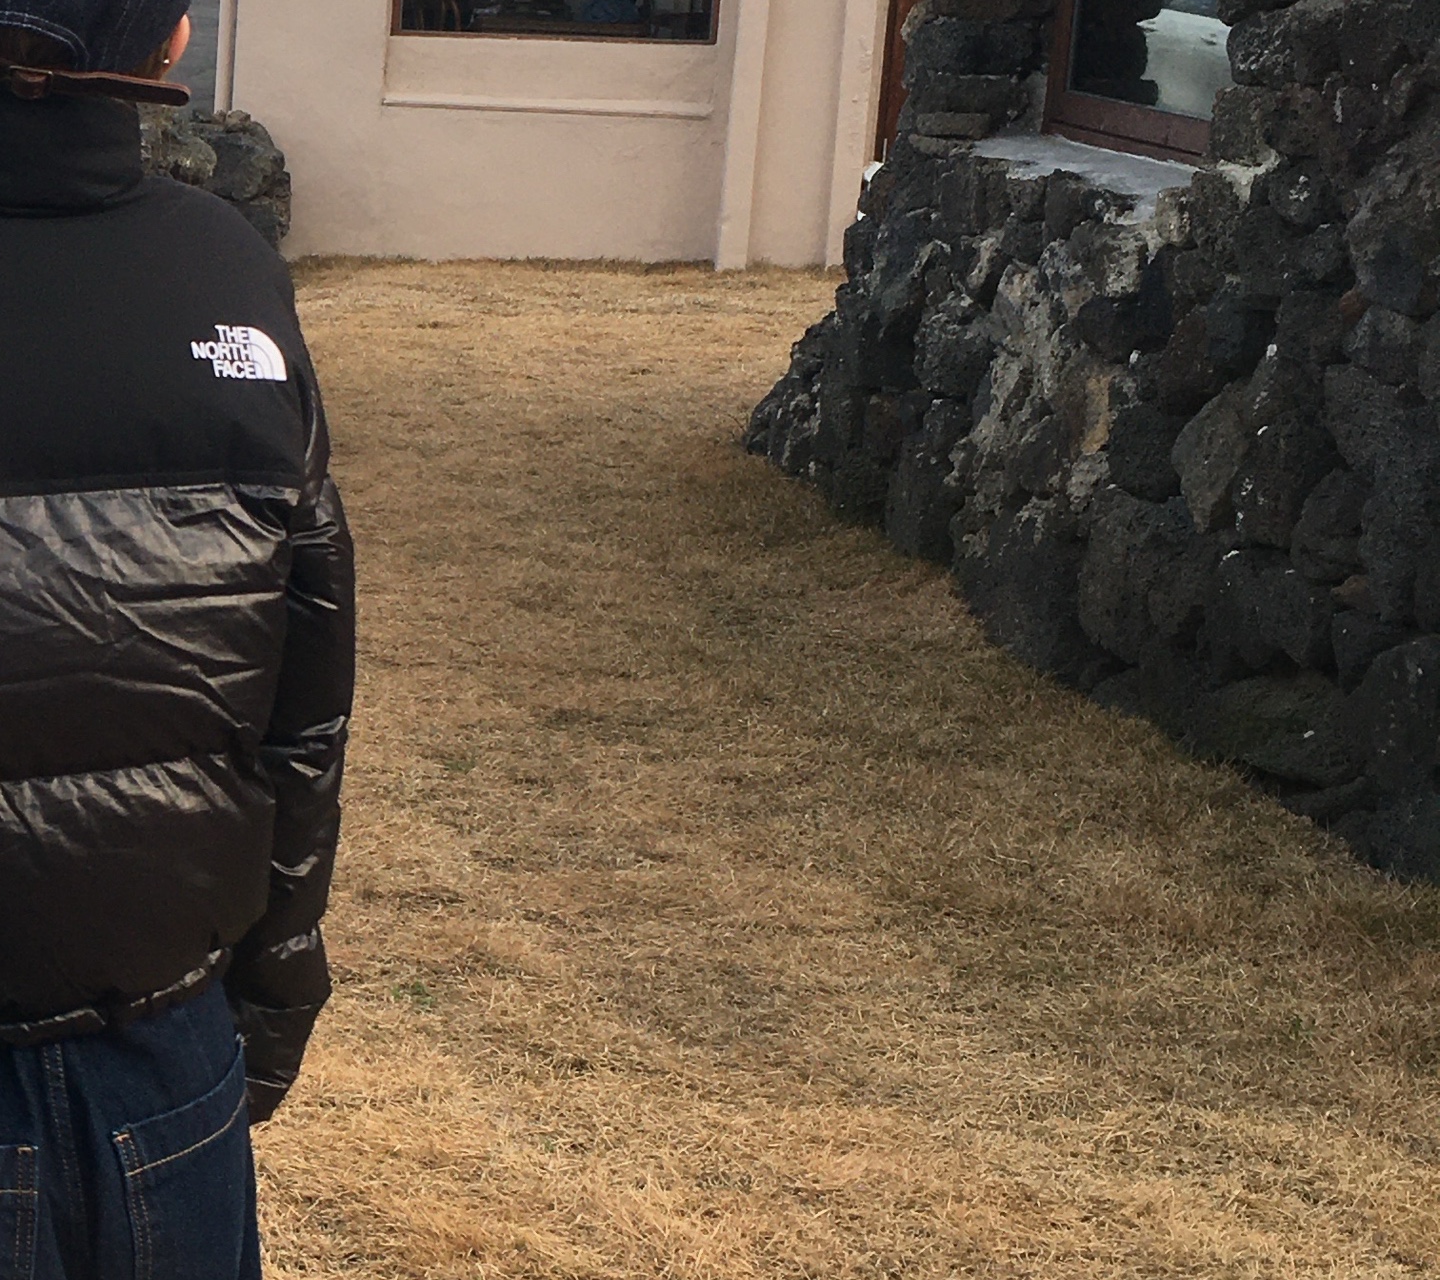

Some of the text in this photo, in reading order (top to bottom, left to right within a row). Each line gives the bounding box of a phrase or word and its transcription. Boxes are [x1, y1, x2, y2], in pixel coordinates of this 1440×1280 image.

[214, 324, 250, 344] THE
[190, 341, 252, 361] NORTH
[212, 360, 256, 379] FACE
